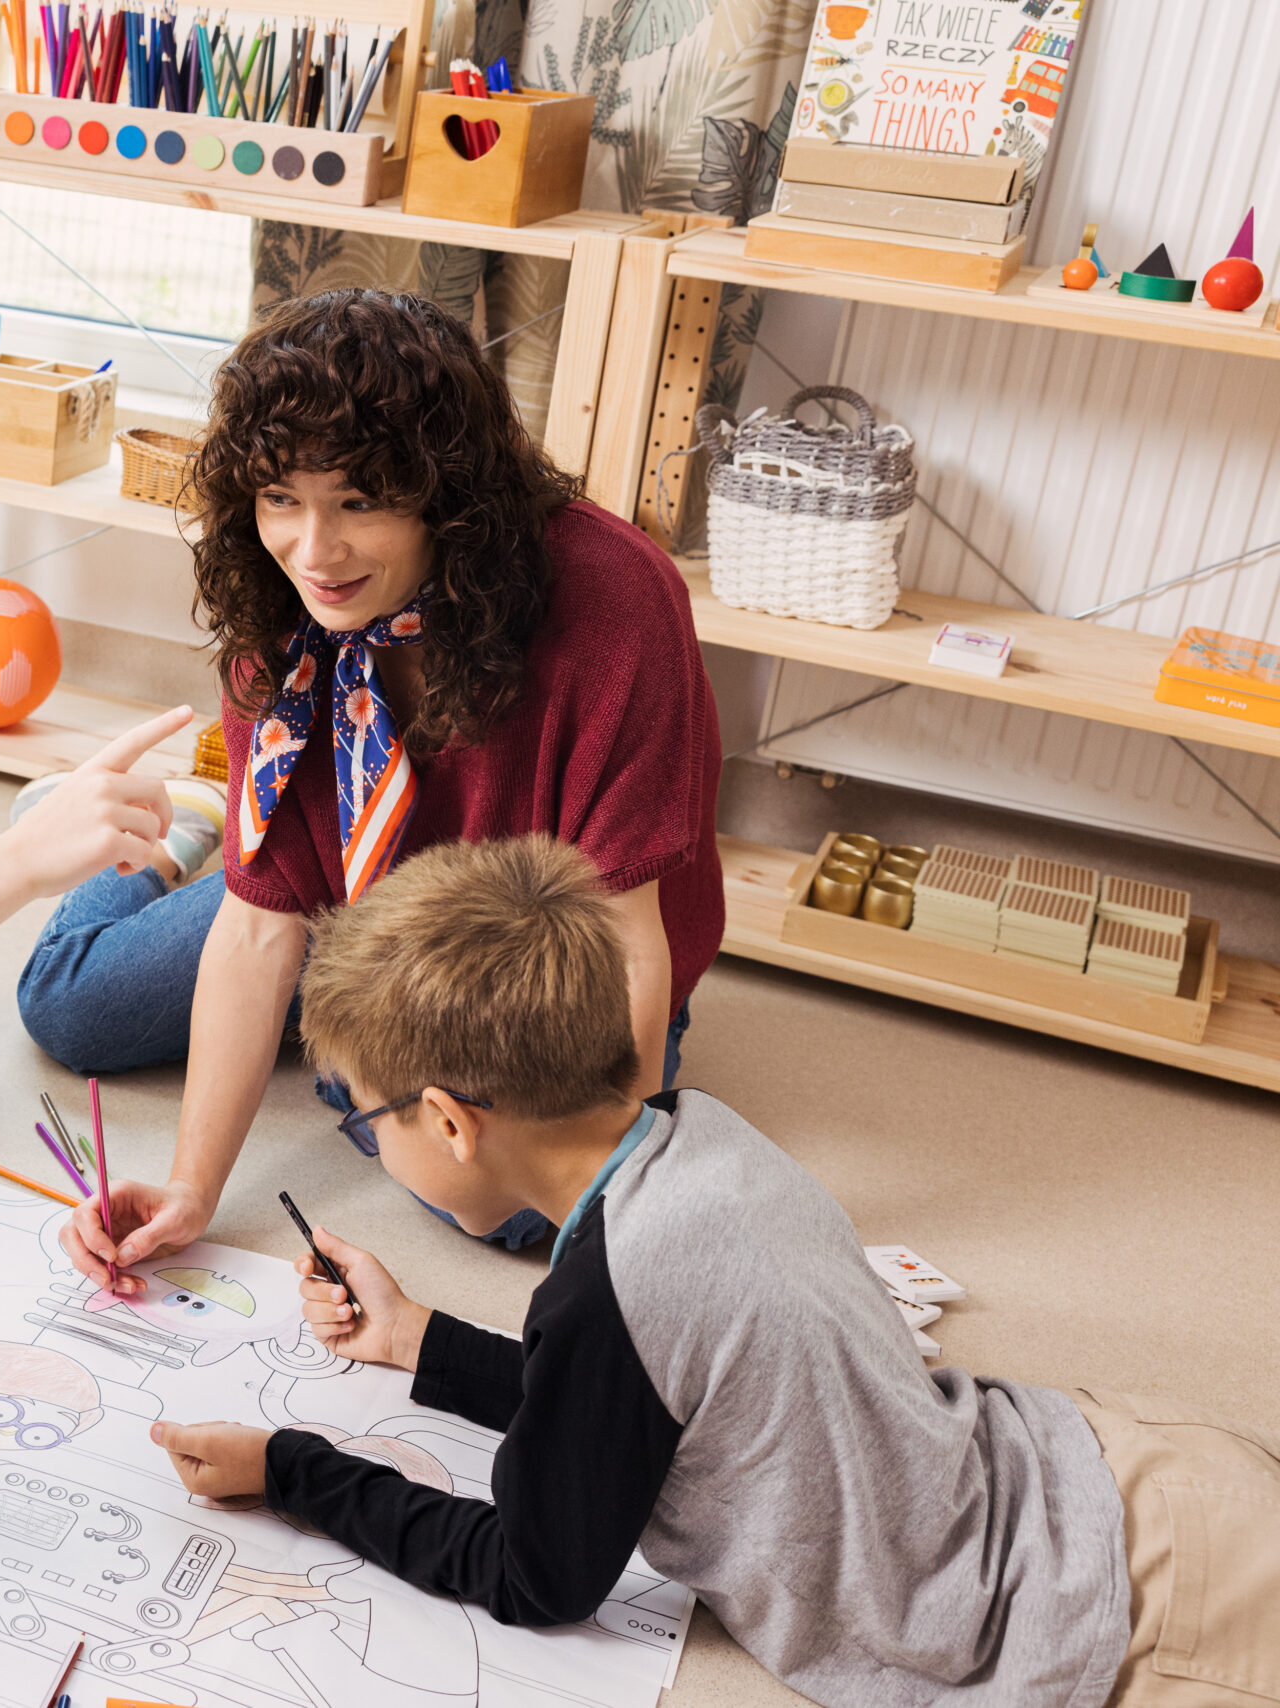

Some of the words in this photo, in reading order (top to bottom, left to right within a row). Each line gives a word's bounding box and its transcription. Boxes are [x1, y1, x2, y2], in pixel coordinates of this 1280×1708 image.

[894, 0, 933, 37] TAK
[936, 4, 1002, 45] WIELE
[886, 39, 995, 66] RZECZY
[874, 69, 908, 95] SO
[912, 78, 986, 105] MANY
[870, 98, 976, 156] THINGS
